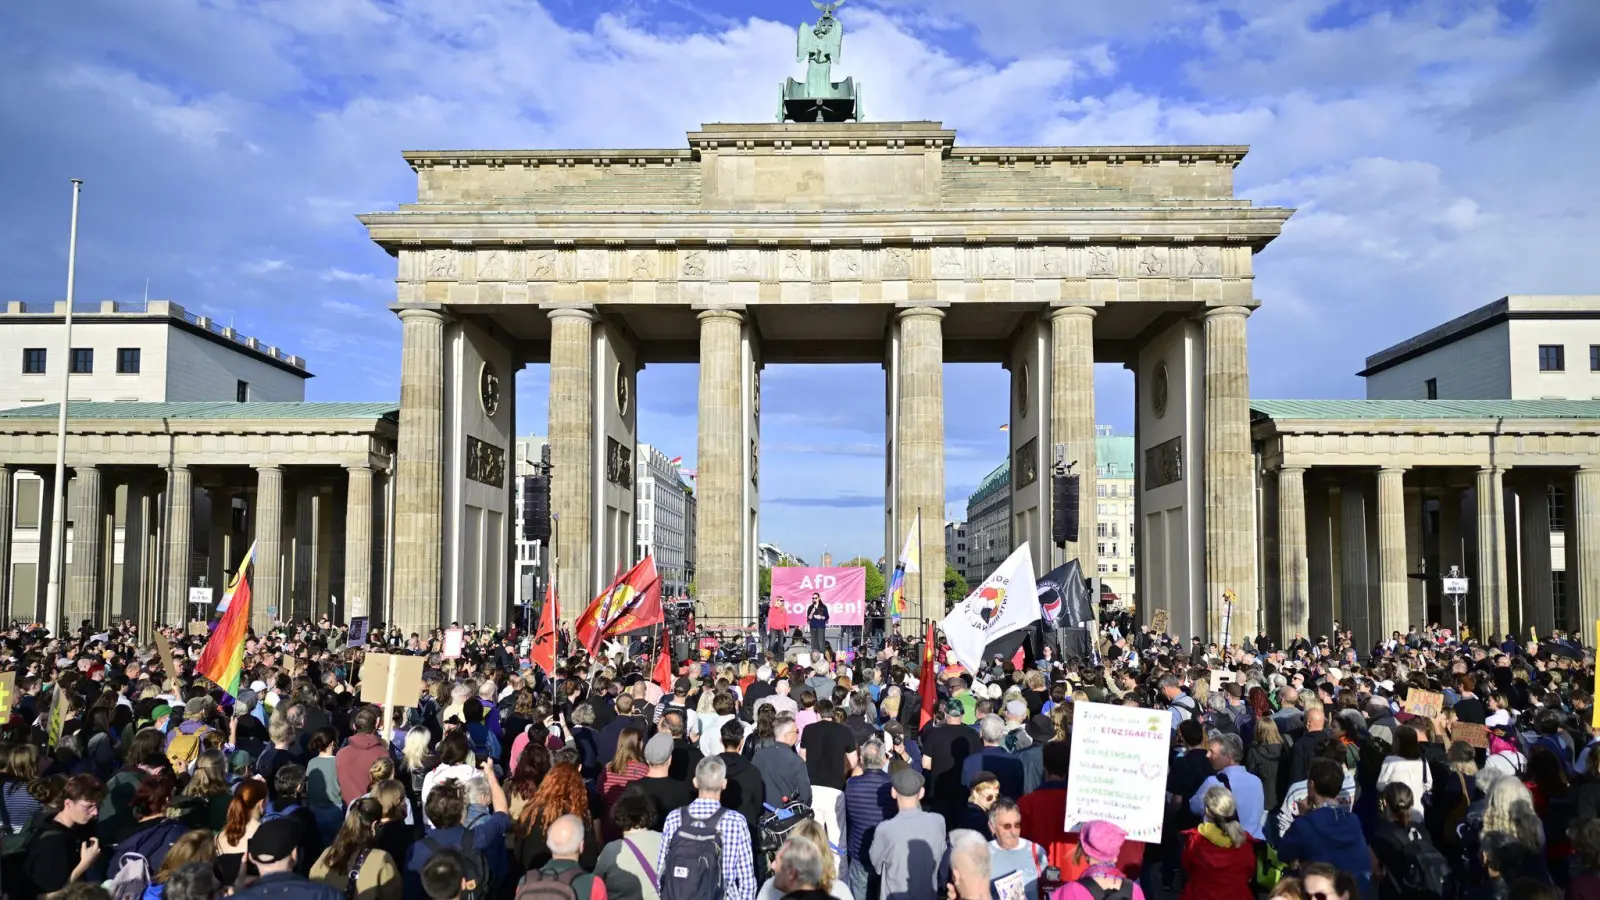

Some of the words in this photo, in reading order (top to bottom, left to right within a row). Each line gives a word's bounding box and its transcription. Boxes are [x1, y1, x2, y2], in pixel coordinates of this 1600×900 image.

[800, 574, 836, 590] AfD
[785, 599, 862, 615] toen!
[1413, 703, 1437, 718] AfD
[1084, 748, 1141, 761] GEMEINSAM
